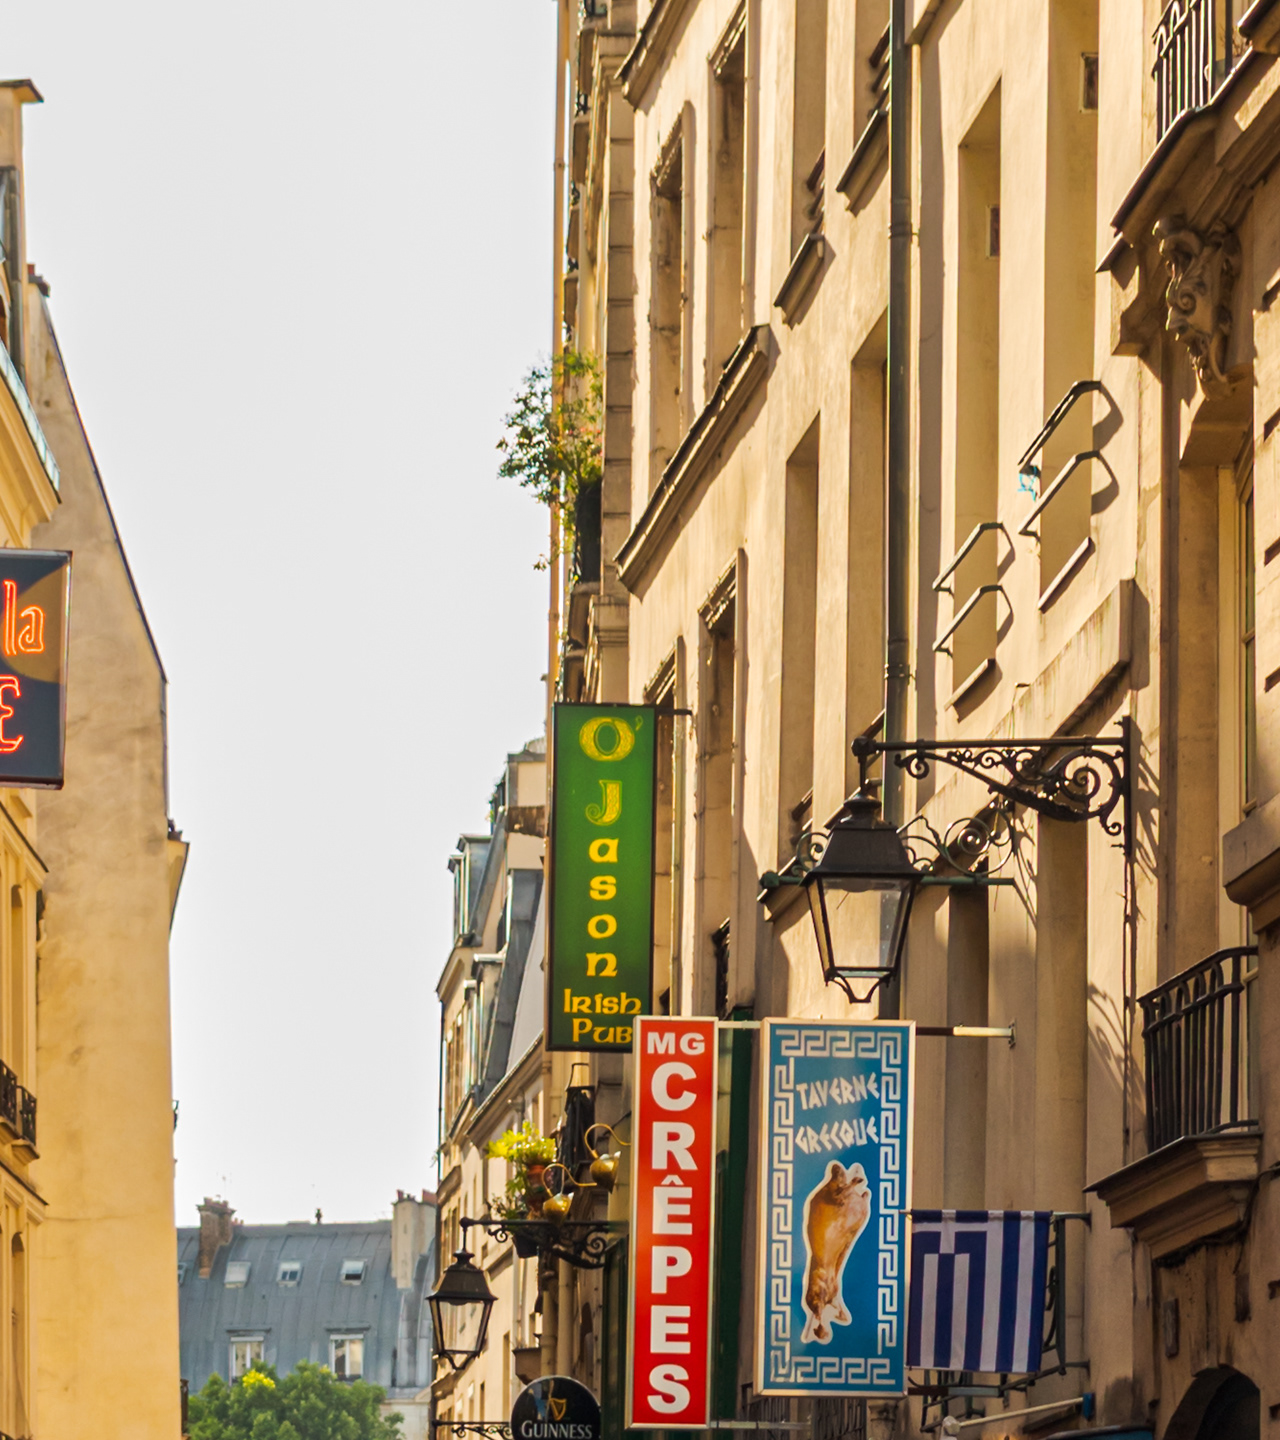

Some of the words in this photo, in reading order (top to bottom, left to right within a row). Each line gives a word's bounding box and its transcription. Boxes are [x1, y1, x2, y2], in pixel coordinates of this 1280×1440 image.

[2, 578, 47, 657] la
[647, 1032, 705, 1055] MG
[796, 1071, 880, 1112] TAVERNE
[795, 1115, 879, 1156] GRECQUE
[645, 1062, 699, 1414] CRÊPES
